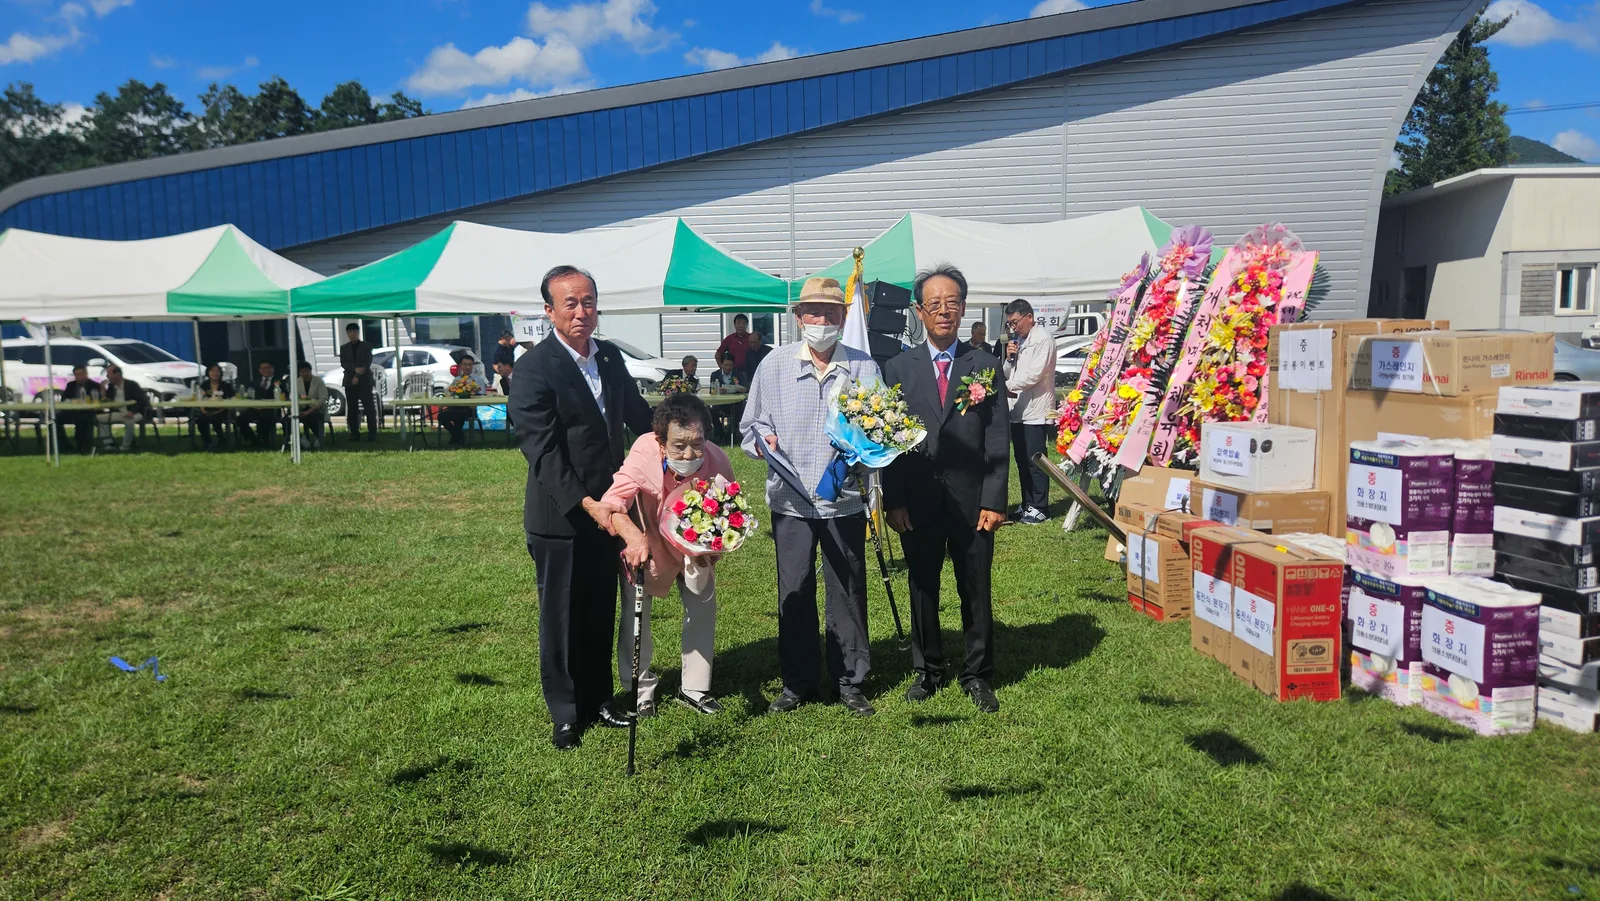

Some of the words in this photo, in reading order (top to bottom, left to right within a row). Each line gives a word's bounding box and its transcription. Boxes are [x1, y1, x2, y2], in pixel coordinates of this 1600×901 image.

[1378, 361, 1415, 372] 가스레인지
[1422, 373, 1449, 384] Rinai
[1515, 369, 1549, 380] Rinnai
[1357, 487, 1387, 502] 화장지
[1357, 616, 1388, 636] 화장지
[1432, 632, 1467, 655] 화장지
